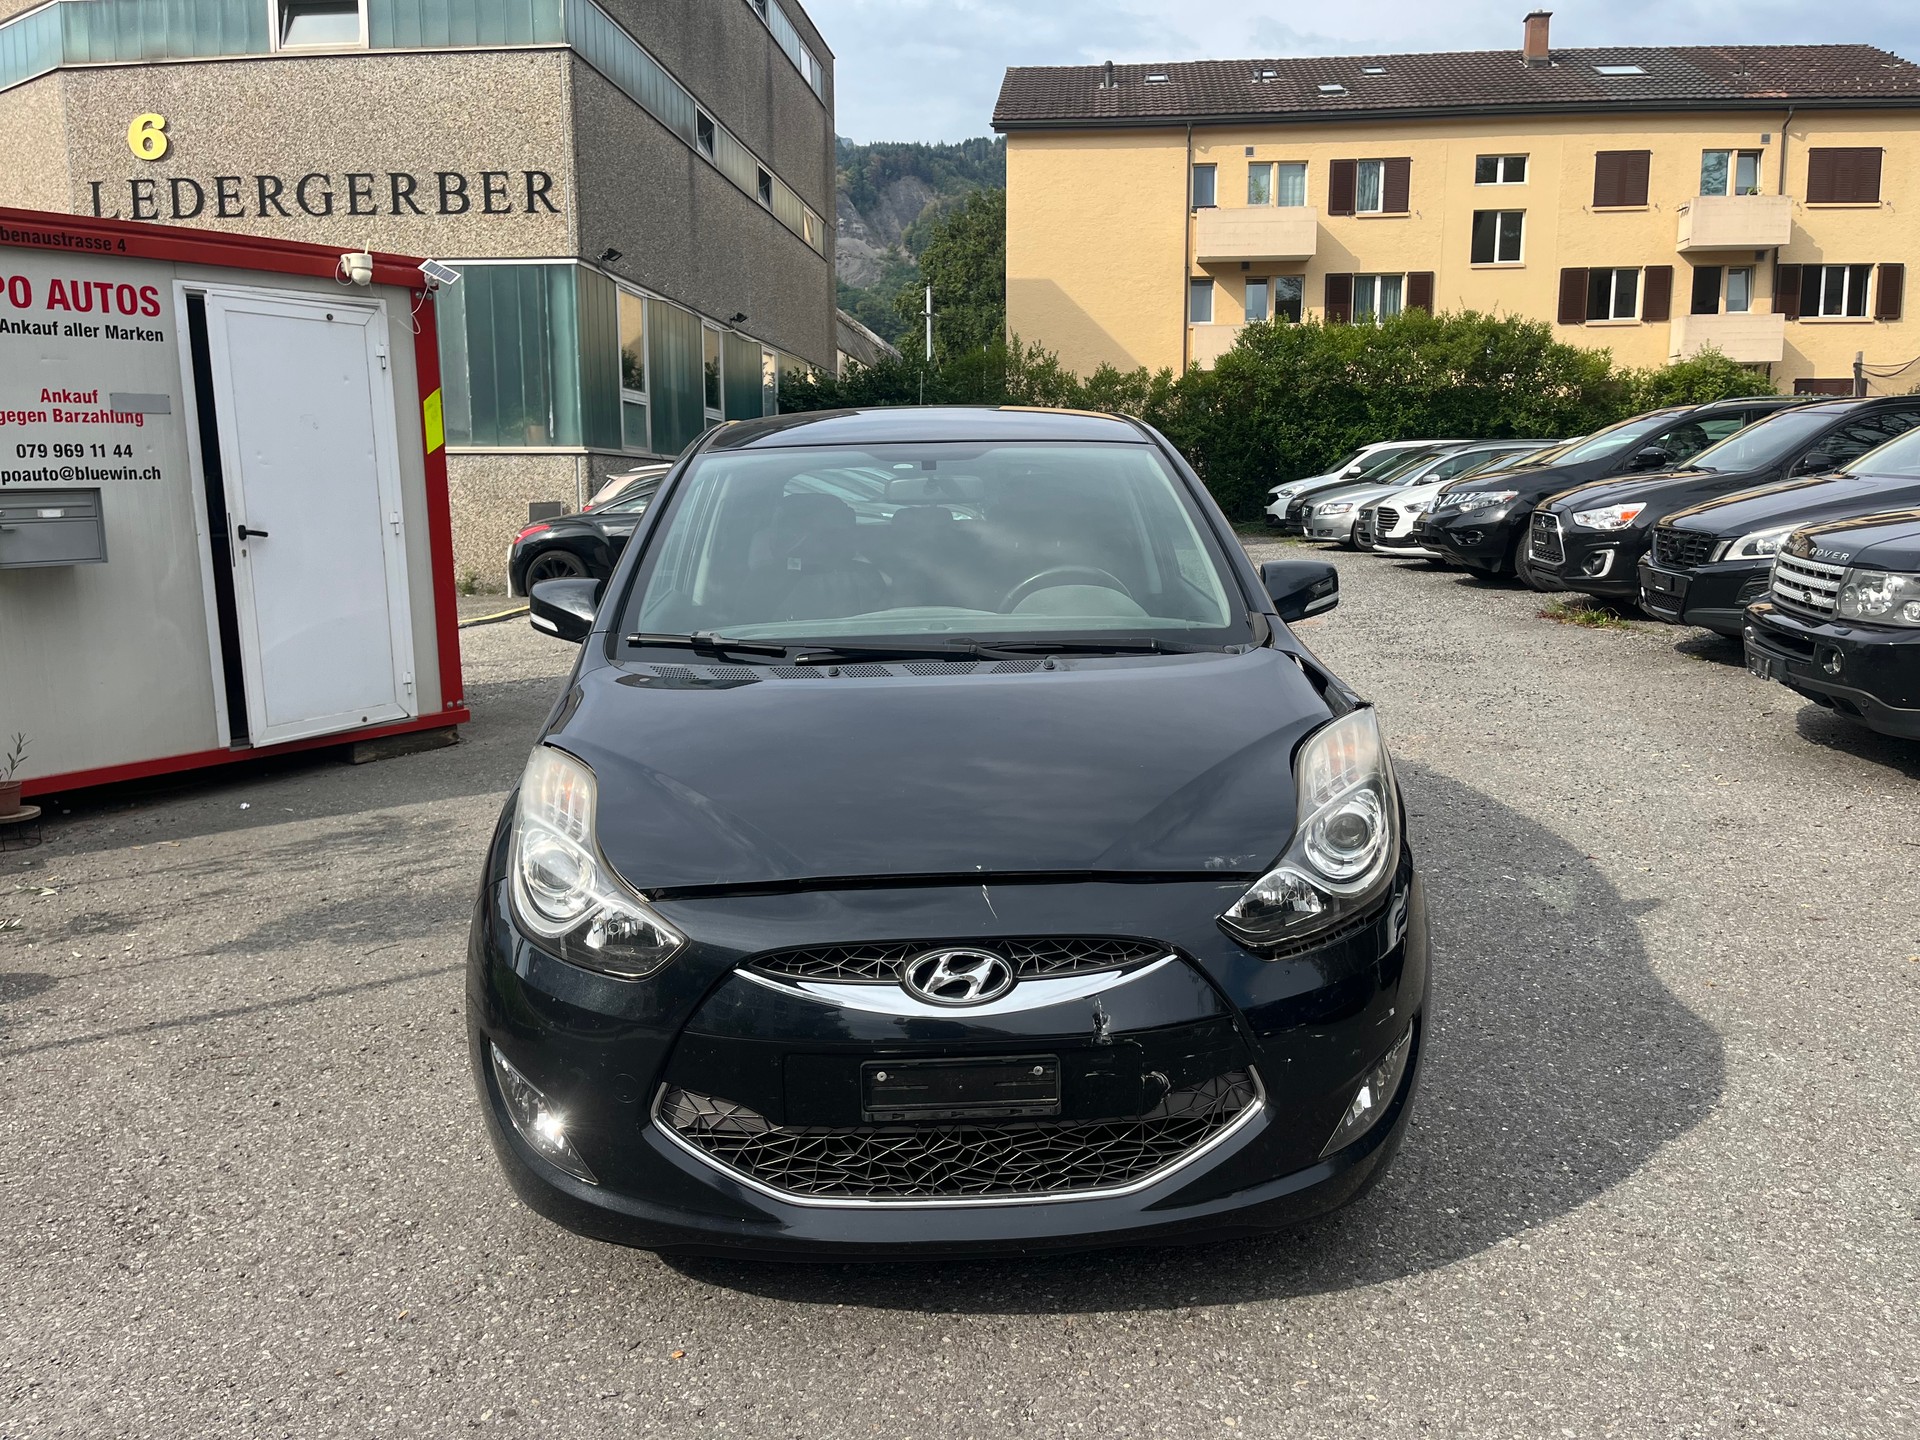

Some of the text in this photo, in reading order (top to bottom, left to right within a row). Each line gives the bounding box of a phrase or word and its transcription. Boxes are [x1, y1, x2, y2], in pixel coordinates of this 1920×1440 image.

[127, 113, 168, 161] 6
[87, 171, 562, 220] LEDERGERBER
[117, 239, 127, 252] 4
[0, 275, 161, 318] O AUTOS
[0, 318, 164, 342] Ankauf aller Marken
[40, 388, 98, 404] Ankauf
[52, 408, 144, 427] Barzahlung
[16, 443, 133, 459] 079 969 11 44
[1808, 547, 1850, 561] ROVER
